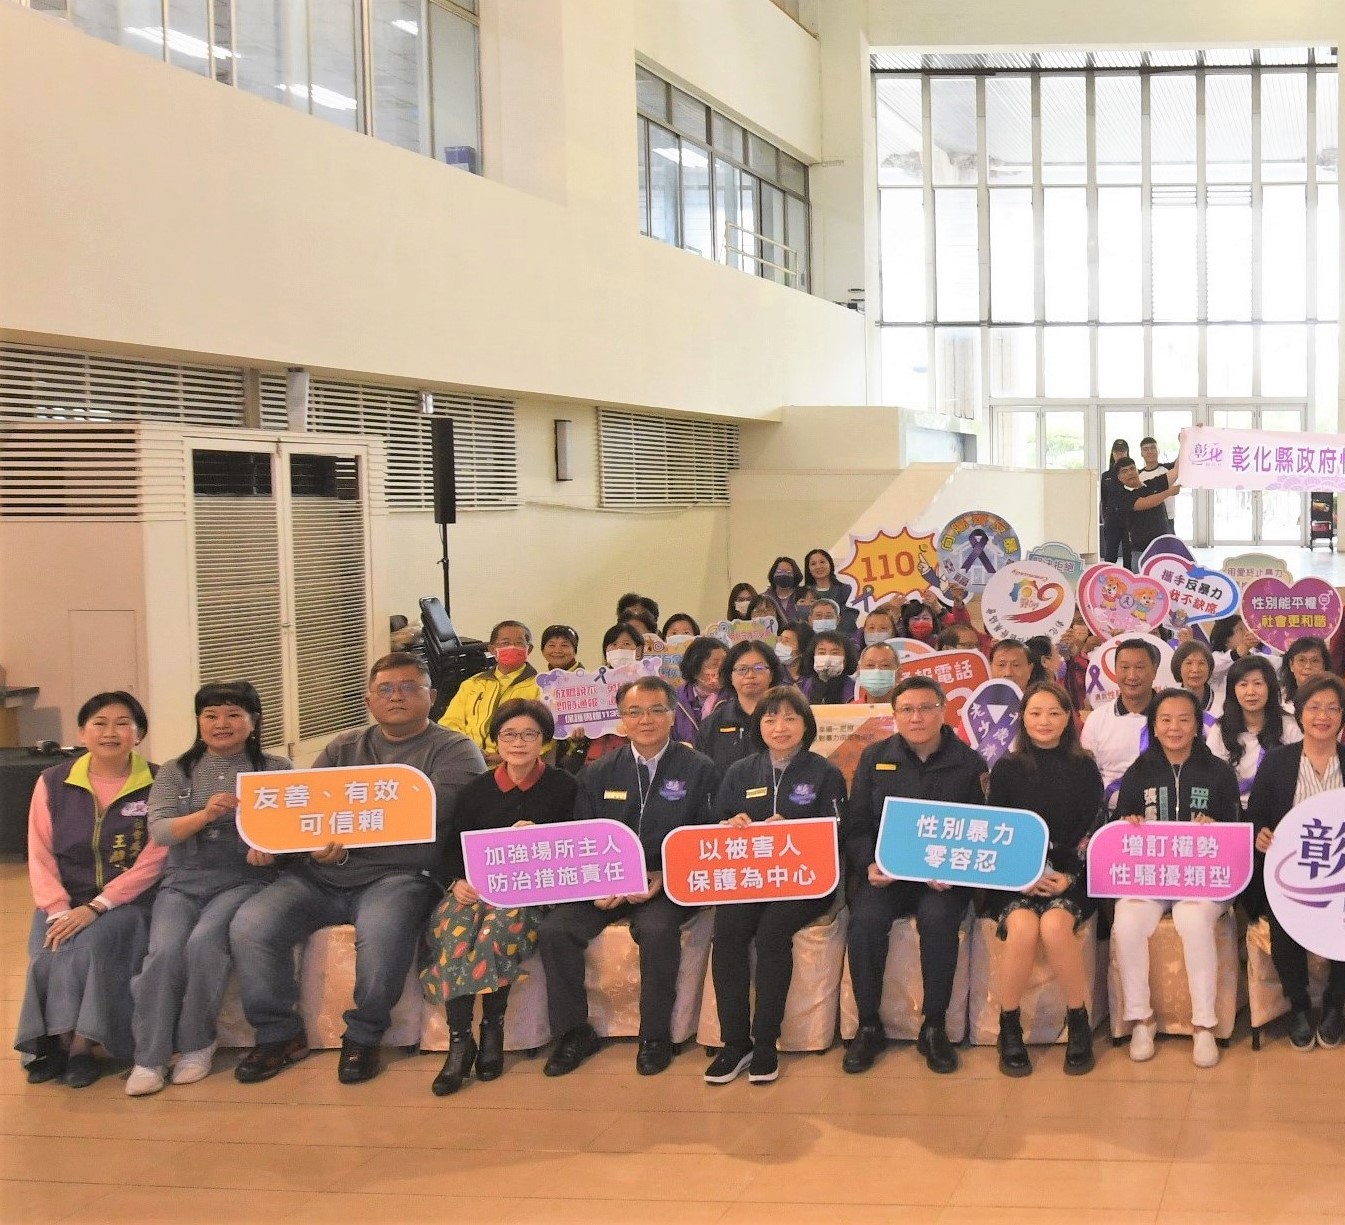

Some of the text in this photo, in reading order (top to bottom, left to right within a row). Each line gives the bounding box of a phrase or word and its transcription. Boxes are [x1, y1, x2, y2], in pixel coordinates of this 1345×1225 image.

[861, 551, 915, 583] 110
[1160, 569, 1223, 600] 攜手反暴力
[1170, 588, 1219, 615] 我不缺席
[1251, 596, 1317, 610] 性別能平權
[1261, 614, 1326, 628] 社會更和諧
[253, 779, 421, 811] 友善、有效、
[299, 808, 385, 836] 可信賴
[916, 814, 1015, 846] 性別暴力
[485, 834, 622, 866] 加強場所主人
[699, 834, 801, 861] 以被害人
[924, 844, 999, 874] 零容忍
[1121, 834, 1219, 858] 增訂權勢
[487, 862, 626, 894] 防治措施責任
[687, 864, 816, 893] 保護為中心
[1109, 862, 1232, 889] 性騷擾類型
